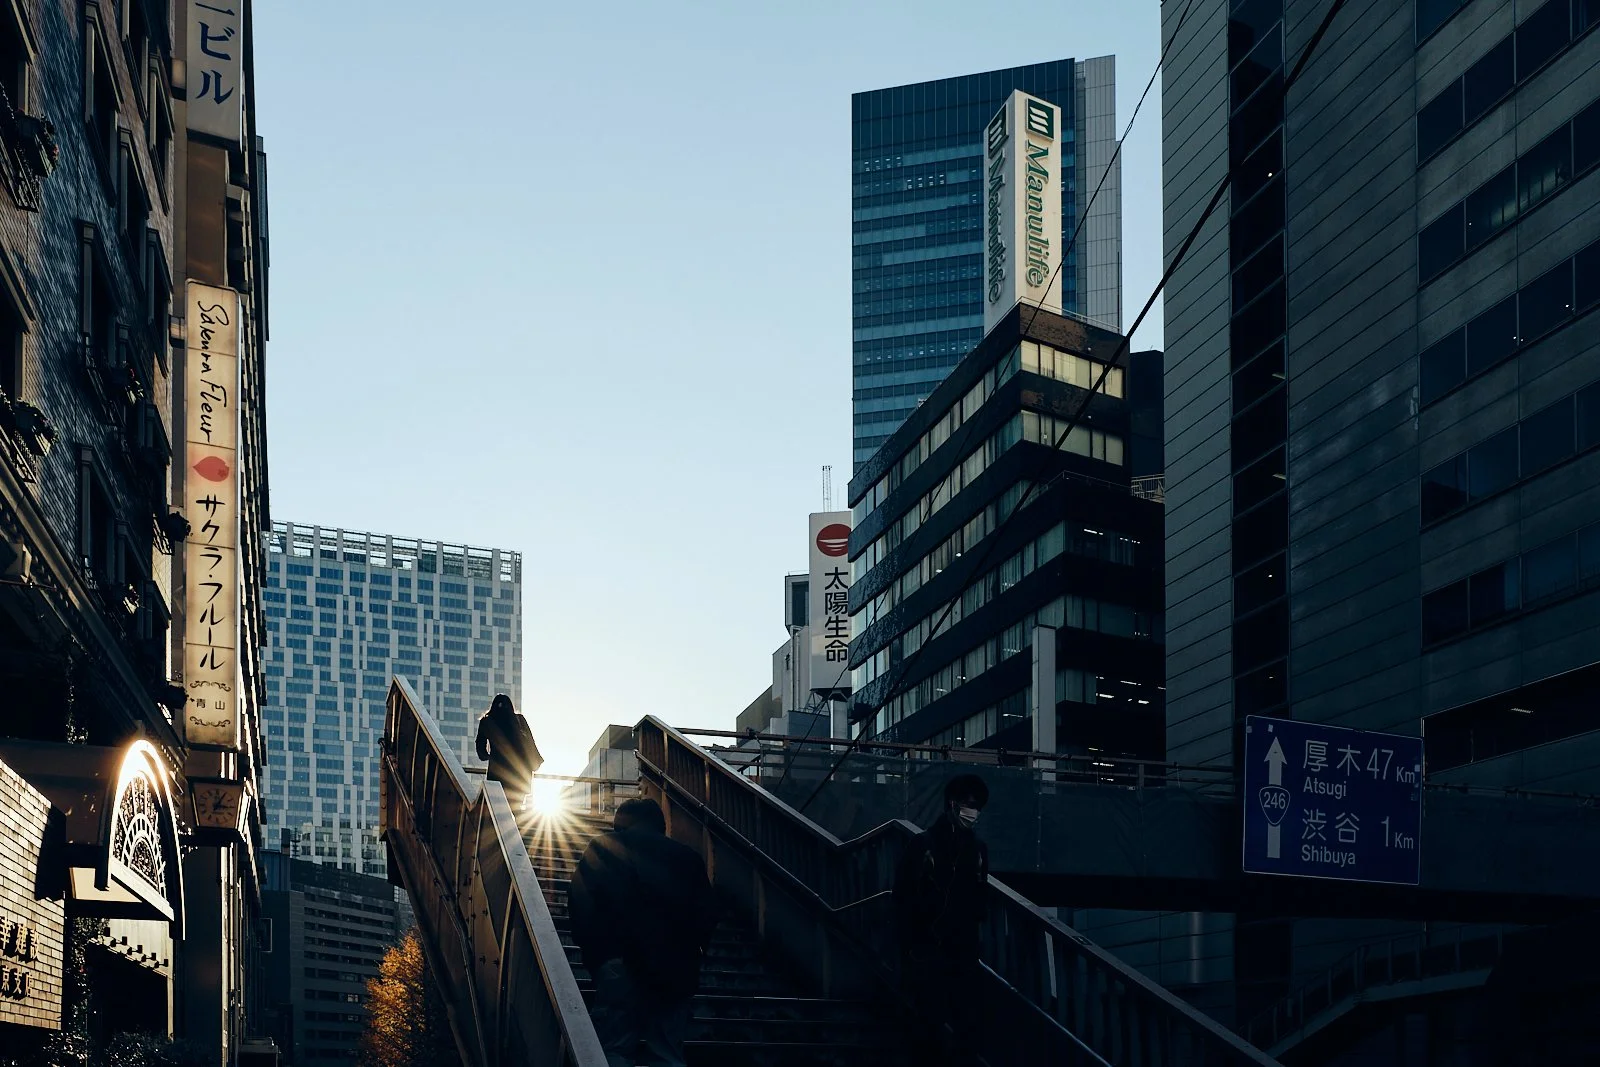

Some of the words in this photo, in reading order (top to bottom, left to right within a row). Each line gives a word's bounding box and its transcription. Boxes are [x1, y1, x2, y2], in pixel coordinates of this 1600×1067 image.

[988, 152, 1006, 305] Manulife
[1025, 139, 1050, 288] Manulife
[198, 301, 230, 373] Sakura
[200, 379, 228, 443] Fleur
[195, 494, 226, 671] サクラ・フルール
[824, 566, 849, 663] 太陽生命
[1303, 739, 1361, 776] 厚木
[1366, 747, 1395, 781] 47
[1303, 776, 1347, 799] Atsugi
[1263, 791, 1286, 810] 246
[1301, 808, 1360, 843] 渋谷
[1380, 815, 1390, 848] 1
[1301, 844, 1356, 868] Shibuya
